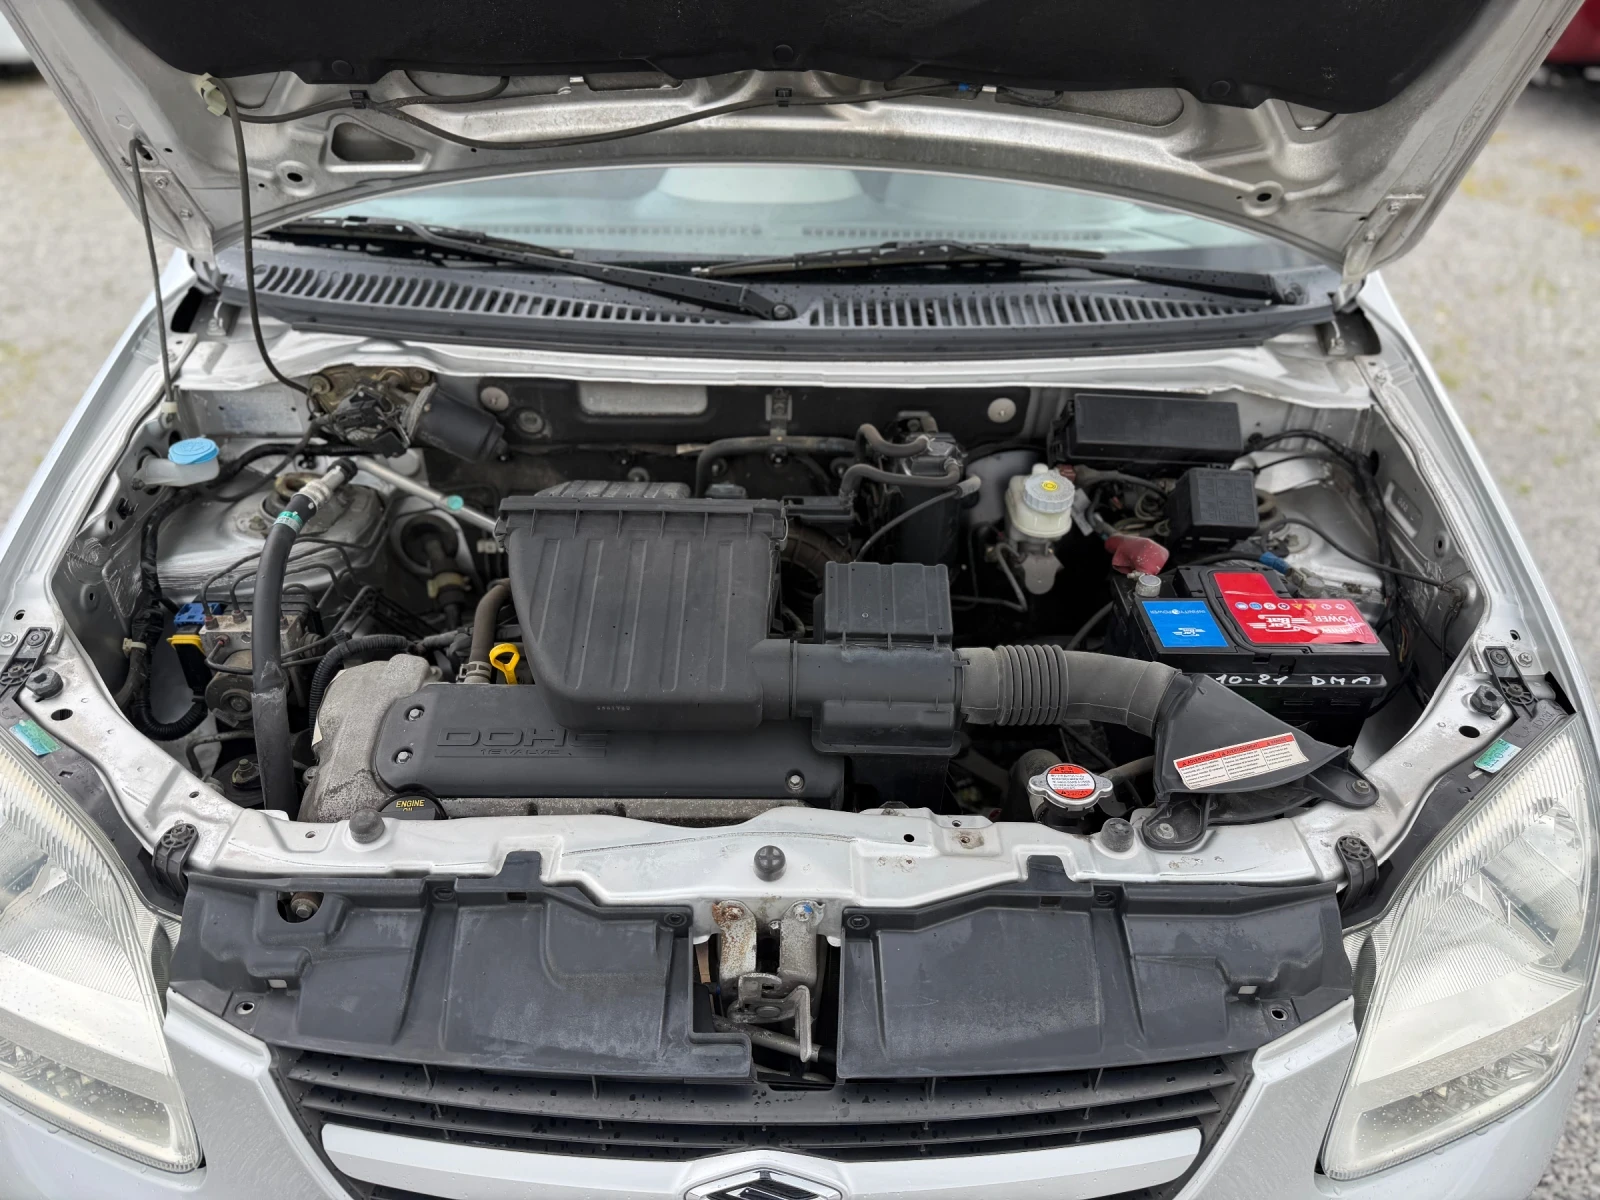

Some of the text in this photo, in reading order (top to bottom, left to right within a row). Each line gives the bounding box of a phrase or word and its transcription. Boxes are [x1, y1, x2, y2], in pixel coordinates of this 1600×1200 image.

[1314, 615, 1355, 623] POWER
[1216, 674, 1288, 686] 10-21
[395, 799, 426, 808] ENGINE
